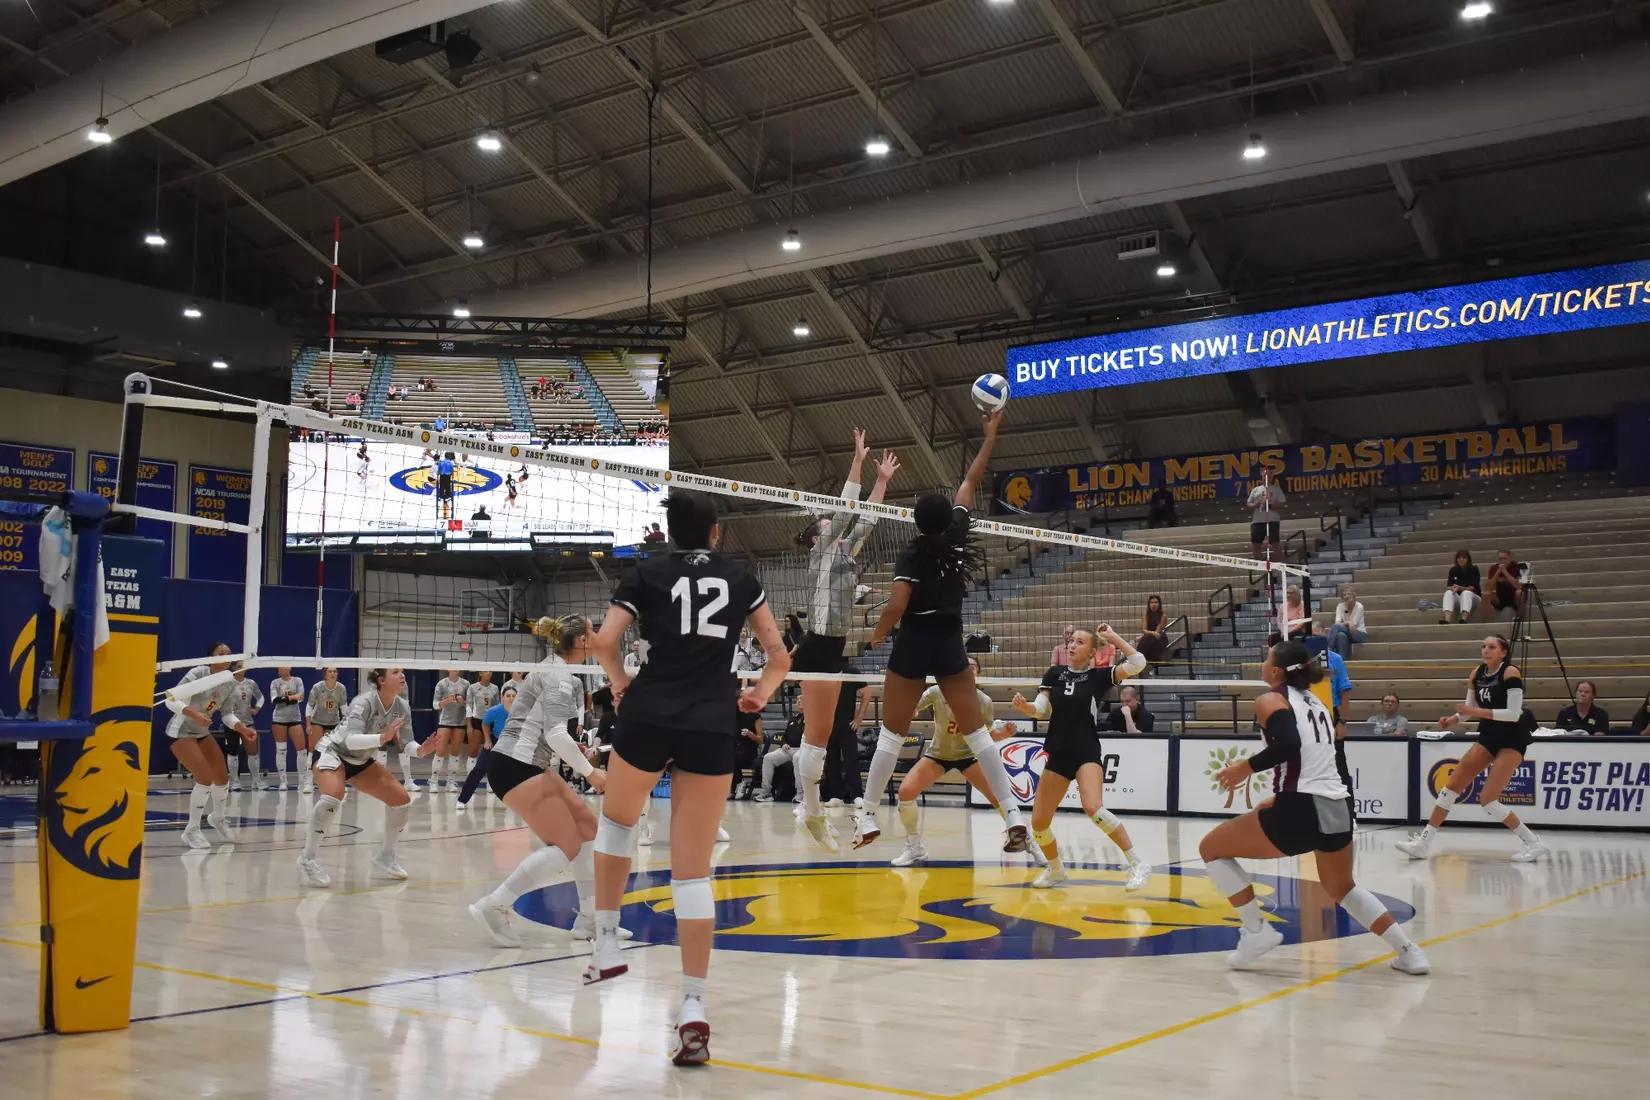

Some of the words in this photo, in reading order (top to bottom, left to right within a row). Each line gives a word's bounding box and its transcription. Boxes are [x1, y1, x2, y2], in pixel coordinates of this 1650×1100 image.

[1016, 358, 1060, 383] BUY
[1066, 345, 1164, 376] TICKETS
[1171, 334, 1238, 363] NOW!
[341, 419, 364, 430] EAST
[367, 423, 393, 436] TEXAS
[395, 428, 414, 439] A&M
[438, 435, 457, 447] EAST
[460, 440, 485, 452] TEXAS
[487, 445, 504, 453] A&M
[20, 450, 55, 462] MEN'S
[22, 458, 52, 468] GOLF
[525, 450, 545, 460] EAST
[546, 453, 569, 463] TEXAS
[570, 457, 585, 466] A&M
[1068, 461, 1150, 492] LION
[1164, 449, 1285, 484] MEN'S
[1301, 423, 1578, 473] BASKETBALL
[12, 467, 67, 480] TOURNAMENT
[137, 472, 155, 480] OLF
[605, 462, 621, 472] EAST
[623, 466, 644, 476] TEXAS
[645, 470, 660, 478] A&M
[1421, 465, 1439, 482] 30
[1444, 455, 1567, 480] ALL-AMERICANS
[0, 475, 23, 488] 98
[28, 479, 66, 493] 2022
[137, 481, 172, 490] AMPIONSHIPS
[215, 474, 252, 486] WOMEN
[225, 482, 250, 491] GOLF
[676, 474, 693, 484] EAST
[694, 478, 713, 487] TEXAS
[713, 481, 727, 489] A&M
[194, 488, 216, 498] NCAA
[217, 491, 252, 500] TOURNAM
[742, 485, 758, 494] EAST
[759, 487, 776, 497] TEXAS
[777, 490, 789, 498] A&M
[1119, 484, 1216, 506] CHAMNSHIPS
[1235, 481, 1242, 496] 7
[195, 496, 226, 510] 2019
[440, 521, 446, 529] 7
[0, 550, 23, 562] 09
[110, 567, 138, 578] EAST
[106, 580, 140, 592] TEXAS
[105, 593, 141, 610] A&M
[671, 576, 730, 639] 12
[1063, 681, 1076, 696] 9
[1478, 687, 1492, 703] 14
[206, 700, 217, 712] 6
[324, 699, 334, 709] 16
[1306, 708, 1333, 745] 11
[1541, 761, 1602, 785] BEST
[1542, 787, 1573, 810] TO
[1577, 787, 1645, 812] STAY!
